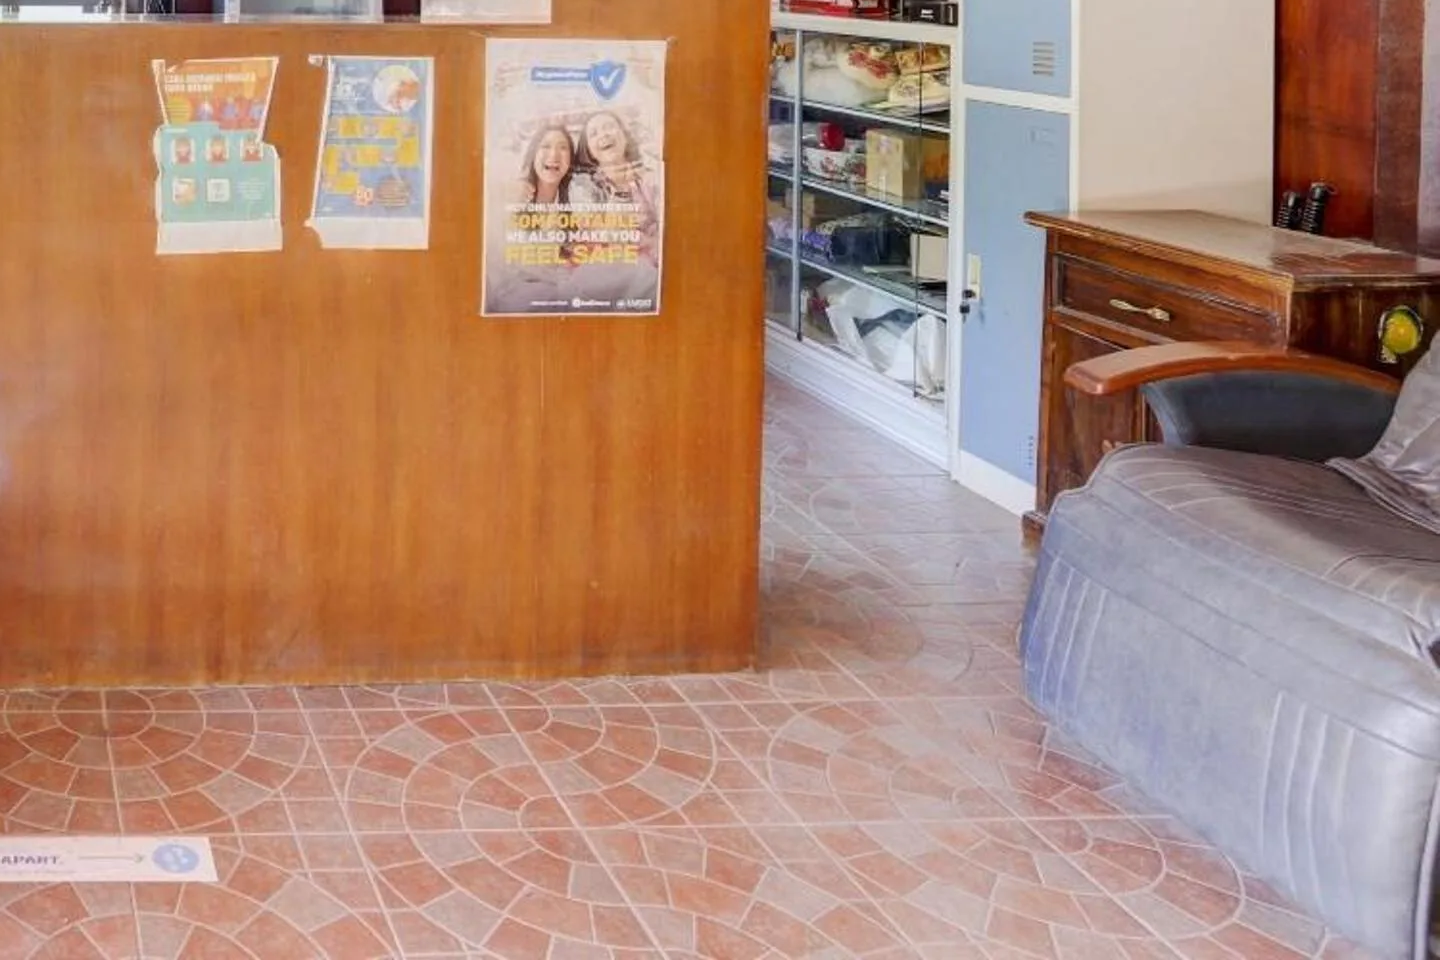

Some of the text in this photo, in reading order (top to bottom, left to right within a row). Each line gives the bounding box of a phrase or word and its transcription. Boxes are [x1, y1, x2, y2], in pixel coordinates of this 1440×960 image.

[509, 213, 640, 229] COMFORTABLE
[528, 230, 566, 242] ALSO
[569, 230, 608, 242] MAKE
[611, 230, 640, 242] YOU
[505, 244, 639, 265] FEEL SAFE
